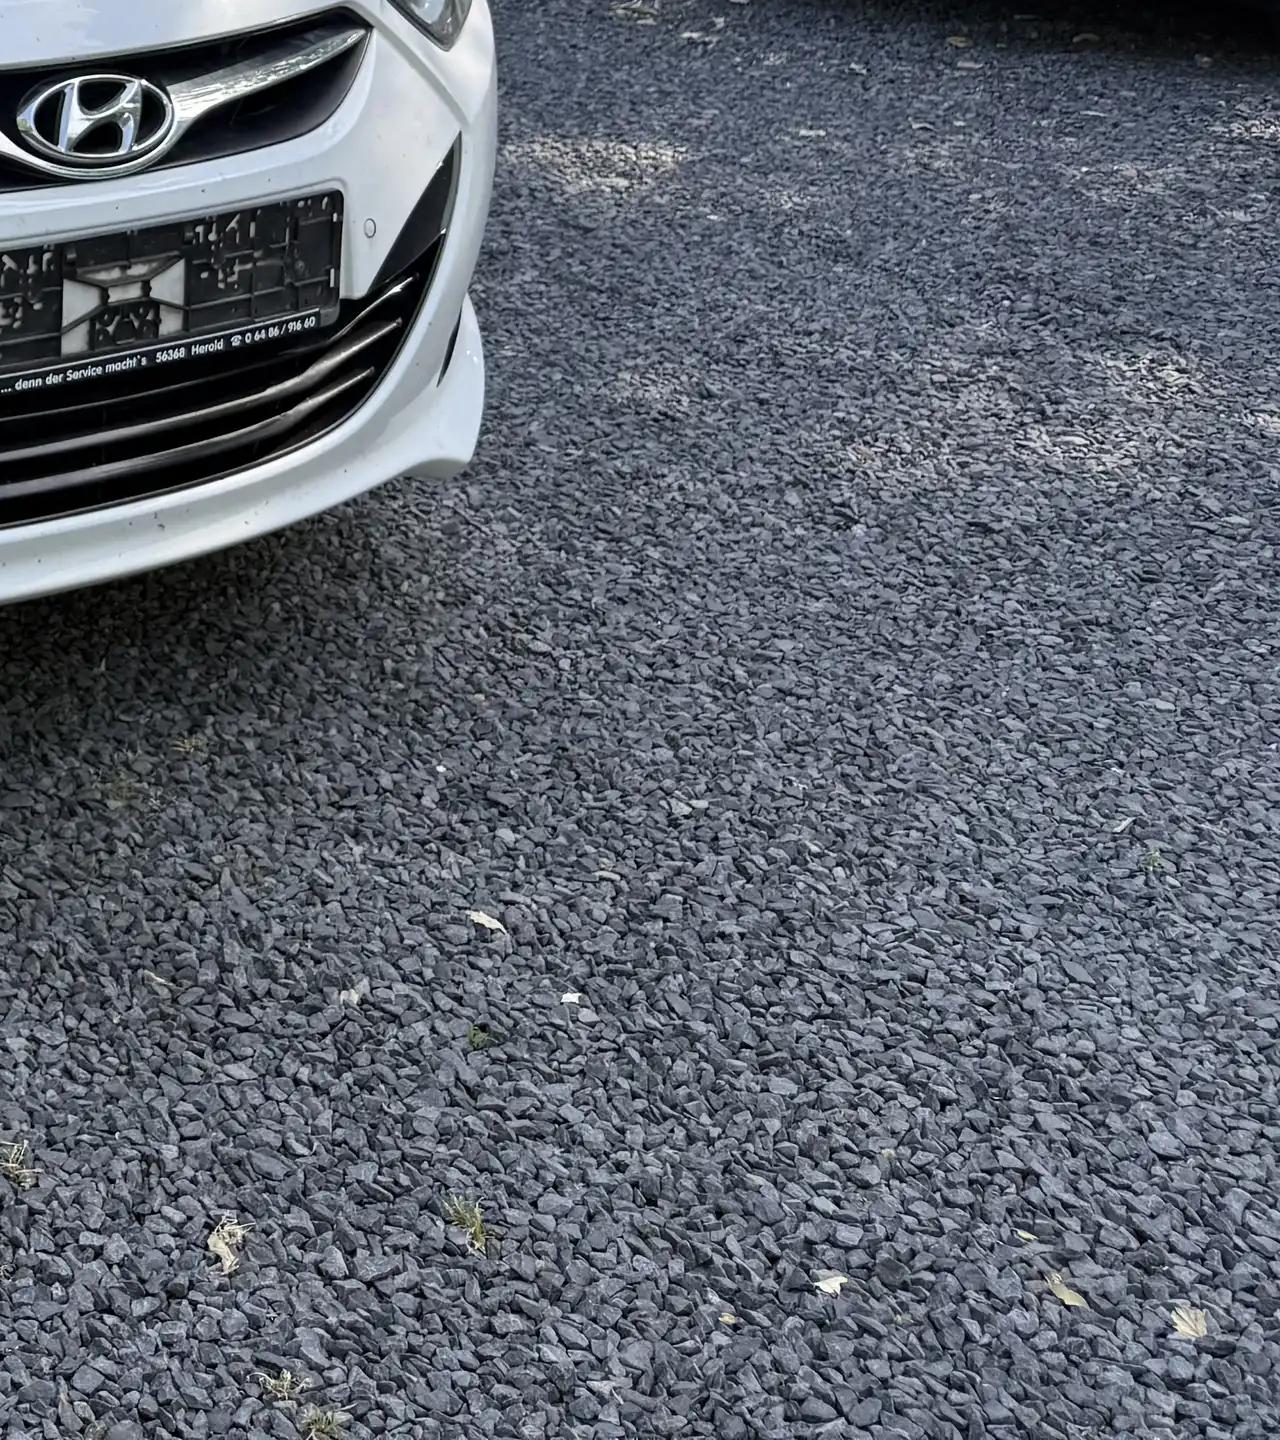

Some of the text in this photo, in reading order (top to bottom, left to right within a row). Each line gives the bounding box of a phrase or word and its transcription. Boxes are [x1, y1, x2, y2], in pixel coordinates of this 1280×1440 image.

[15, 377, 42, 390] denn
[45, 373, 64, 385] der
[66, 365, 103, 381] Service
[155, 347, 185, 363] 56368
[191, 339, 224, 356] Herold
